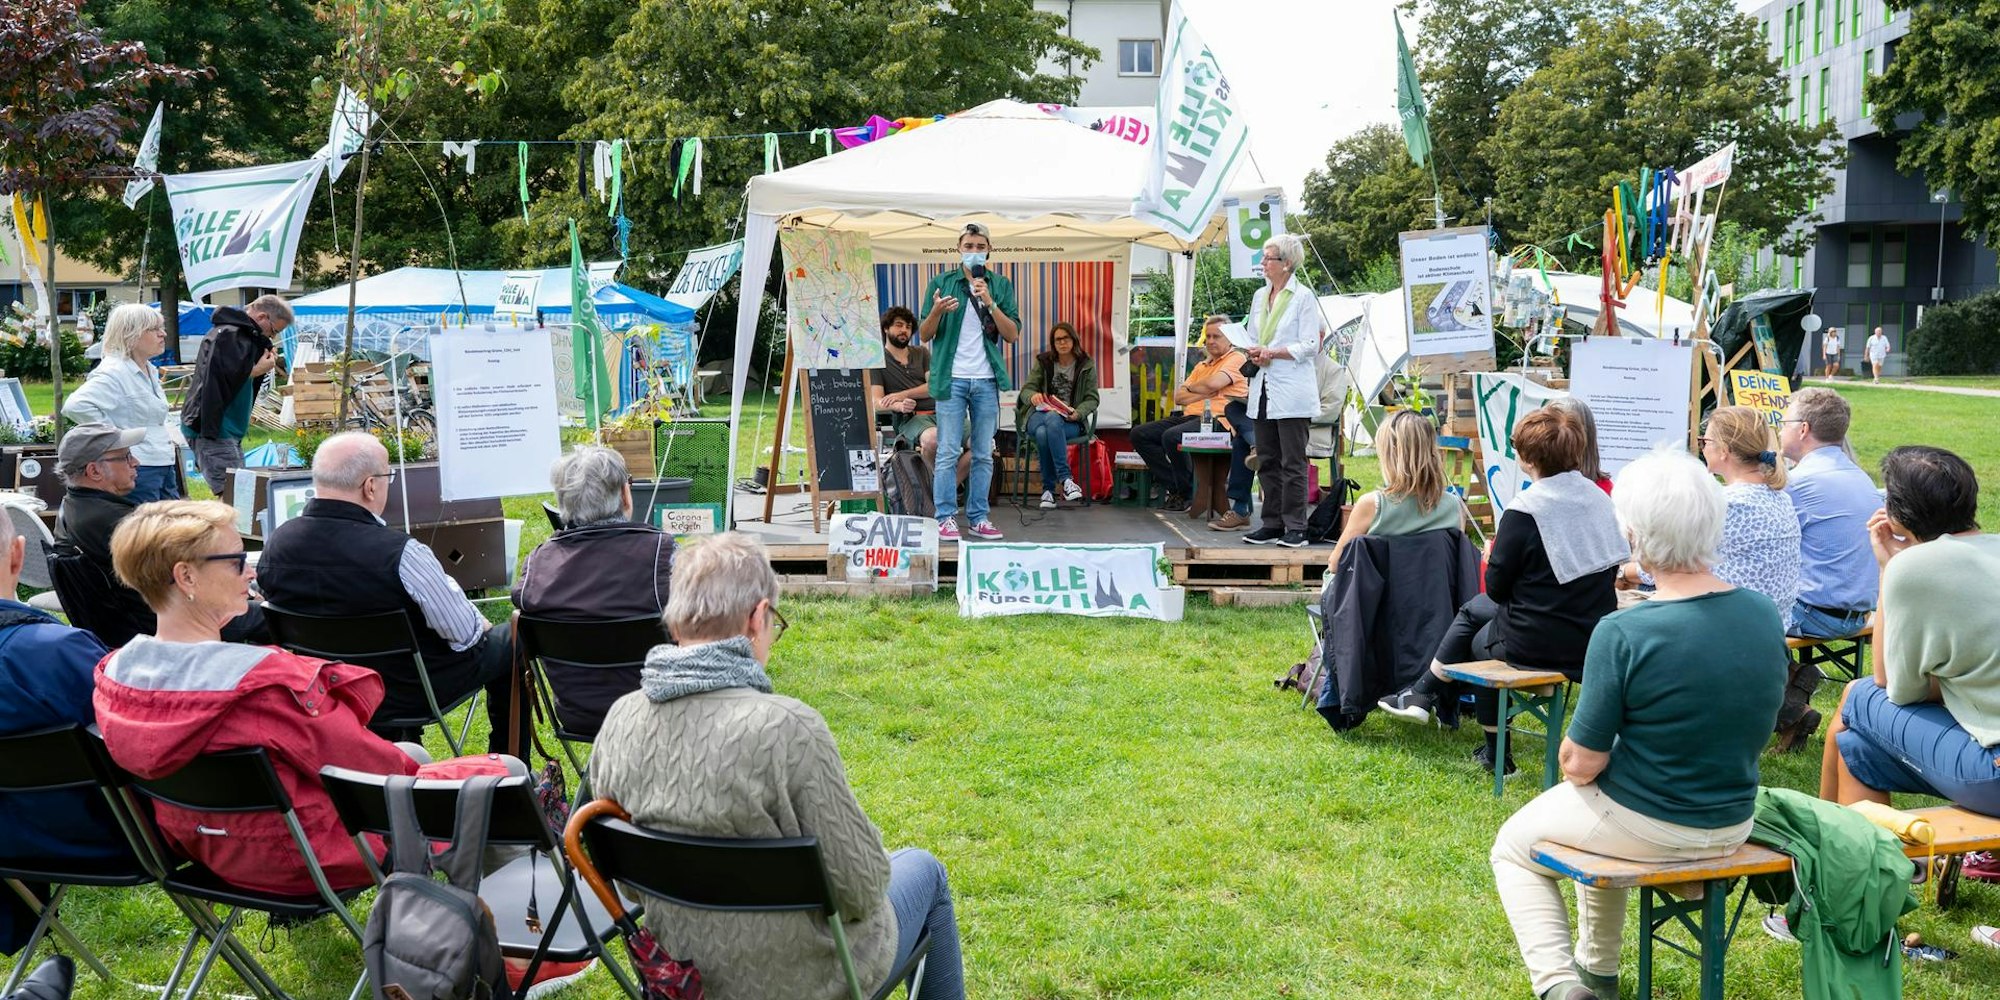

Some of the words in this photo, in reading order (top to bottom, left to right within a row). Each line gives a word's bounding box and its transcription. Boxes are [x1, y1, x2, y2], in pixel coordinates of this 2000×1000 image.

[175, 208, 241, 241] ÖLLE
[1442, 269, 1475, 277] Klimaschutz!
[670, 520, 701, 533] Regeln
[843, 516, 924, 547] SAVE
[977, 561, 1087, 592] KÖLLE
